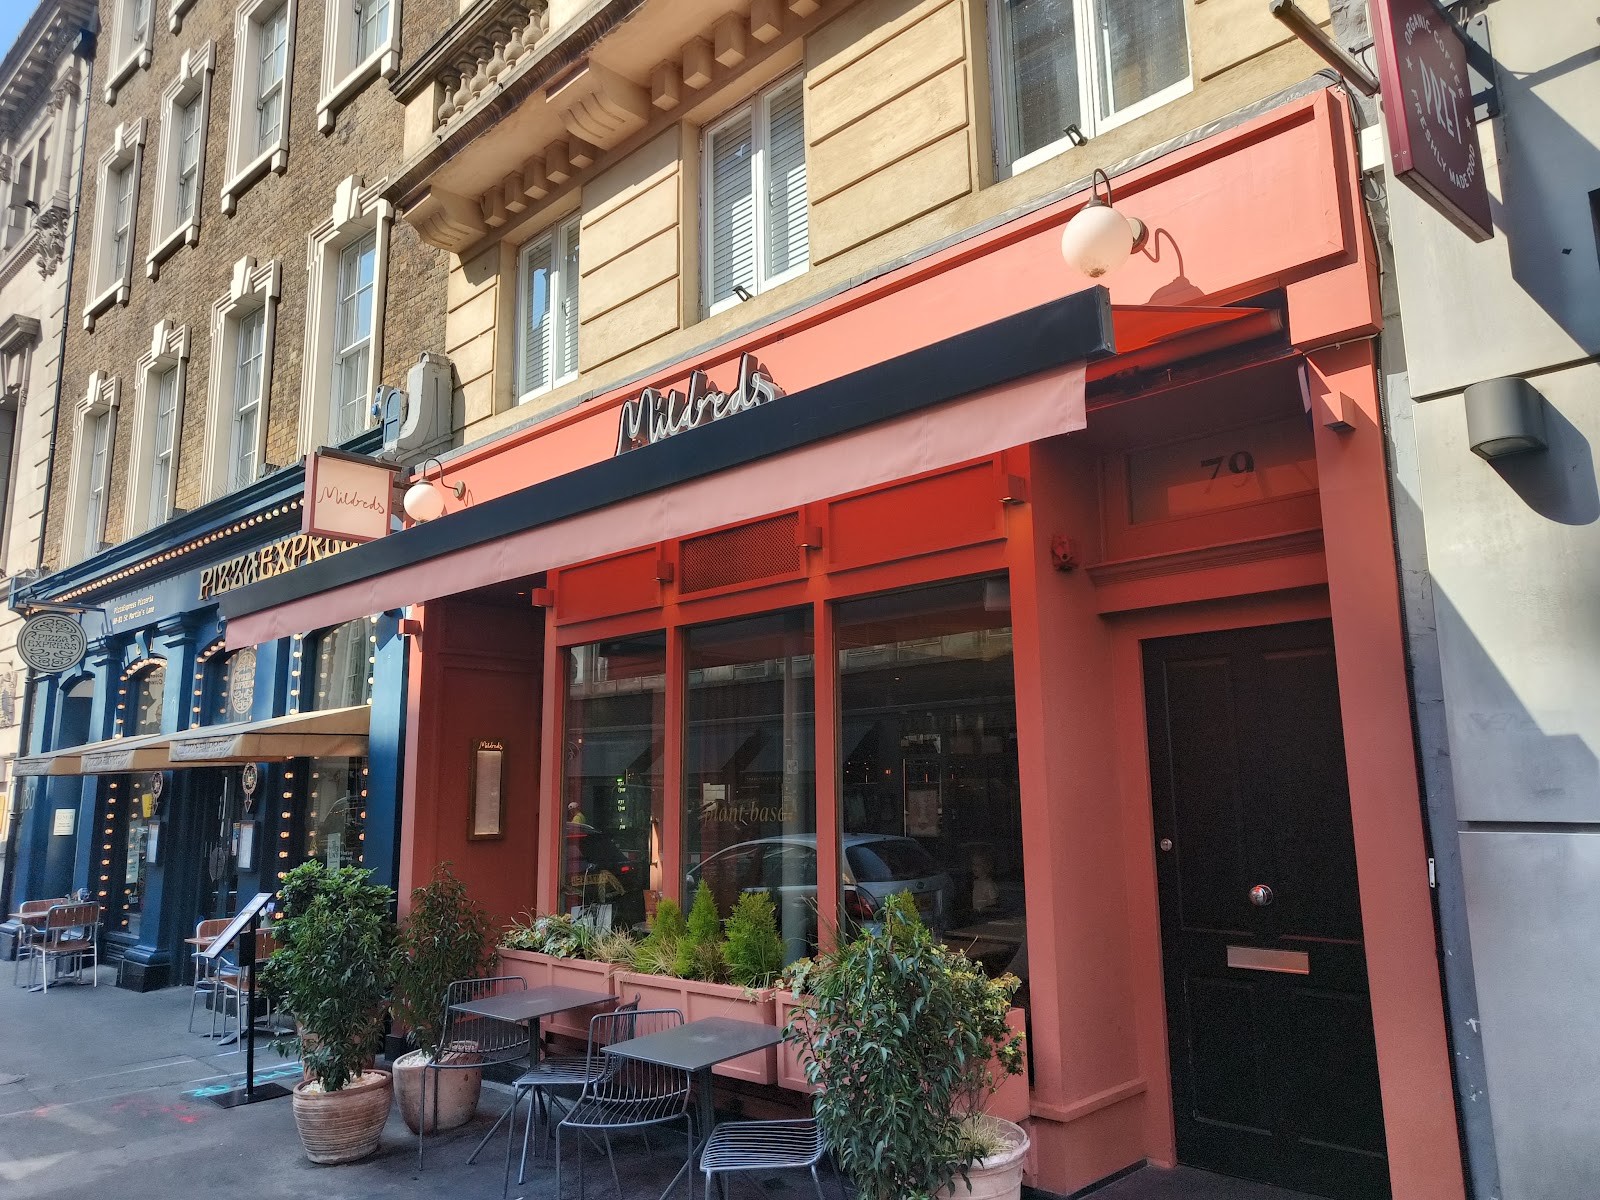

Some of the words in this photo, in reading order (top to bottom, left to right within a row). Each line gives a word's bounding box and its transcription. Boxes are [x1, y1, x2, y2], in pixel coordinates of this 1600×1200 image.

[1404, 14, 1432, 46] ORGANIC
[1433, 29, 1465, 99] COFFEE
[1418, 56, 1462, 145] PRET
[1411, 88, 1447, 173] FRESHLY
[1448, 168, 1470, 190] MADE
[1466, 143, 1476, 183] FOOD
[613, 351, 776, 457] Mildreds
[317, 486, 385, 514] Mildreds
[197, 533, 364, 601] PIZZAEXPR
[27, 640, 77, 651] EXPRESS
[37, 633, 69, 643] PIZZA
[478, 740, 504, 750] Mildreds
